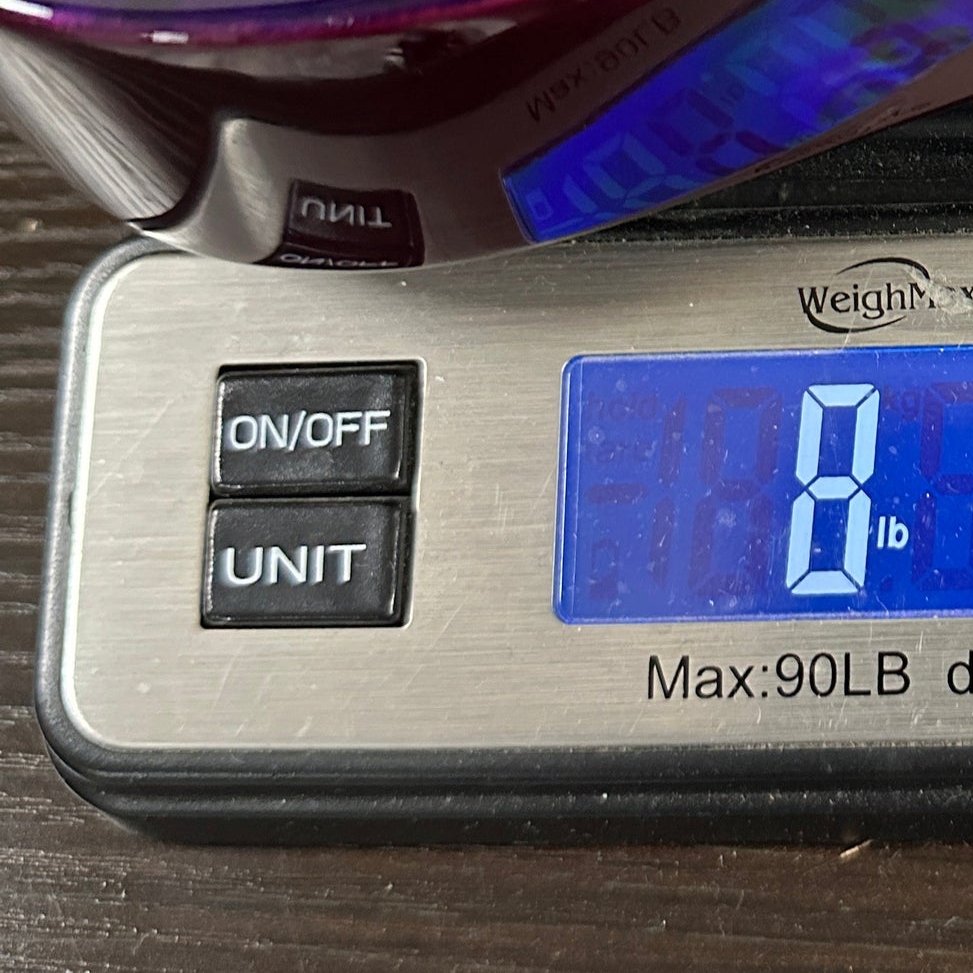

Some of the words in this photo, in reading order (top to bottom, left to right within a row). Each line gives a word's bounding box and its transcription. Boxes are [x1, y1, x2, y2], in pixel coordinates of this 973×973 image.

[228, 409, 392, 452] ON/OFF
[785, 383, 880, 595] 8
[877, 516, 910, 550] lb
[222, 543, 367, 586] UNIT
[647, 652, 911, 701] Max:90LB
